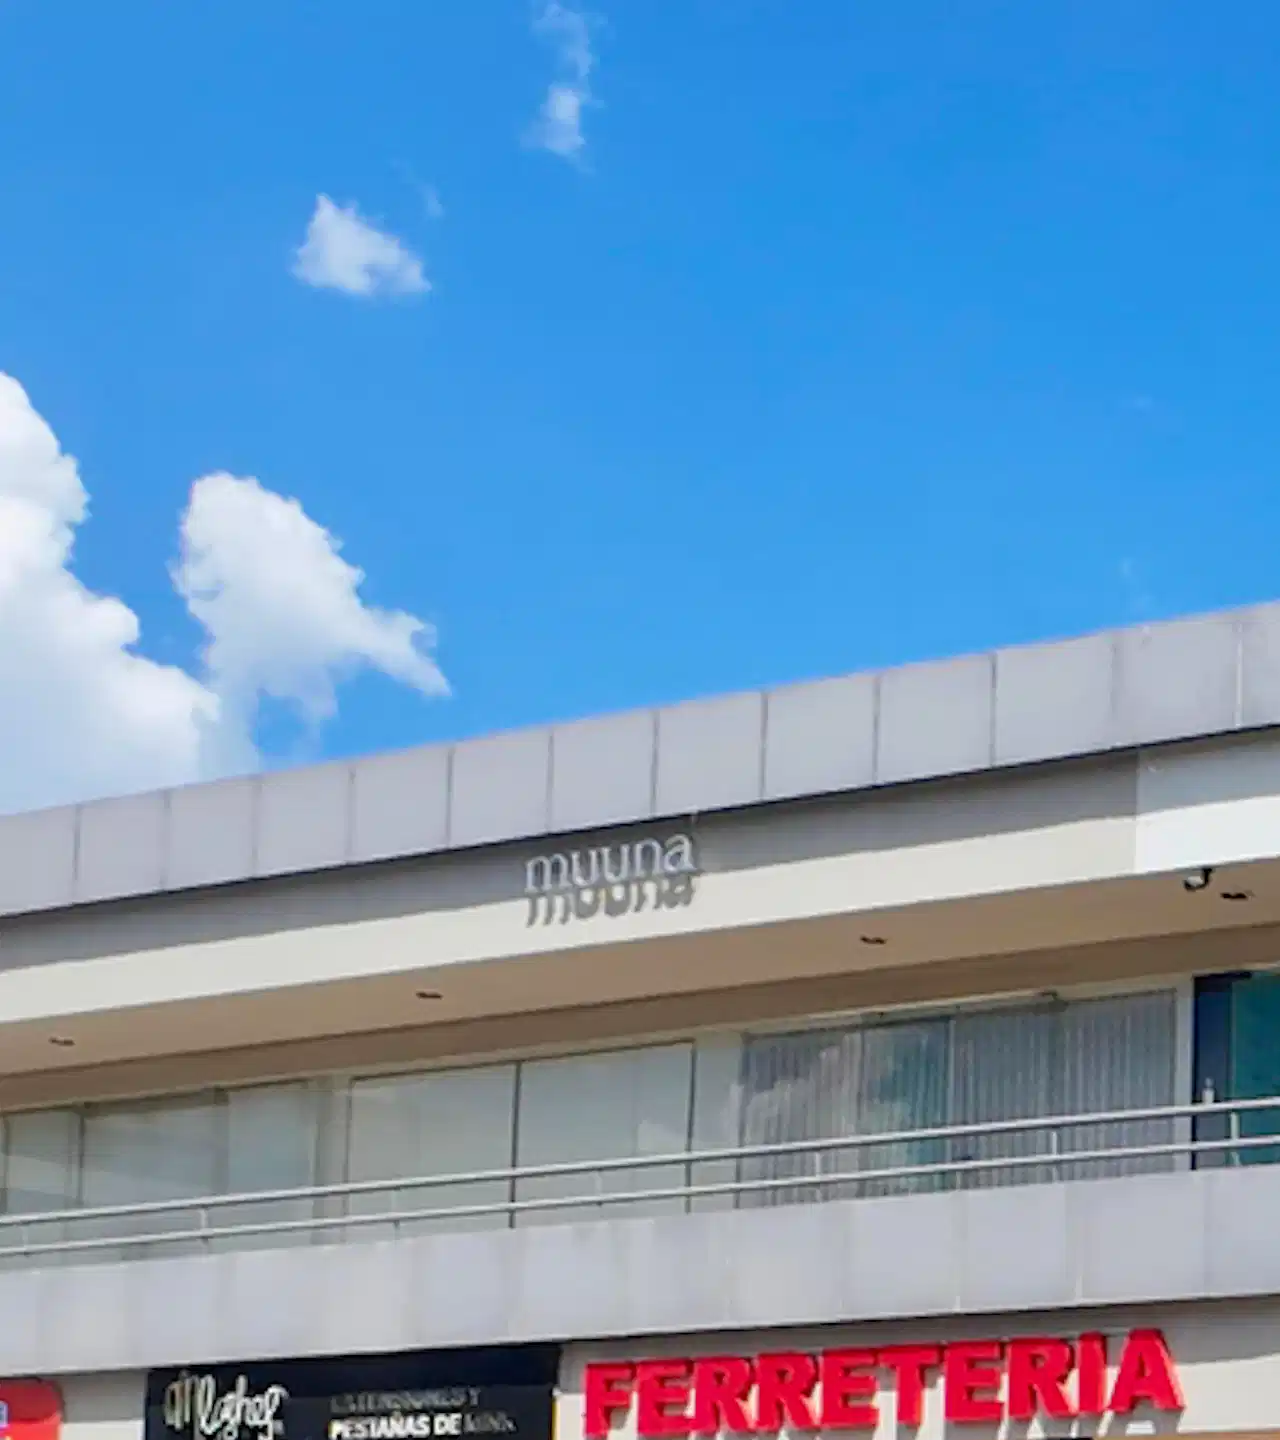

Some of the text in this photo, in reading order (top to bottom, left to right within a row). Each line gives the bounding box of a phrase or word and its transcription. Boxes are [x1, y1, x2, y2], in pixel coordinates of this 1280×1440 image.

[523, 832, 697, 893] muuna
[583, 1328, 1185, 1436] FERRETERIA
[433, 1412, 463, 1436] DE
